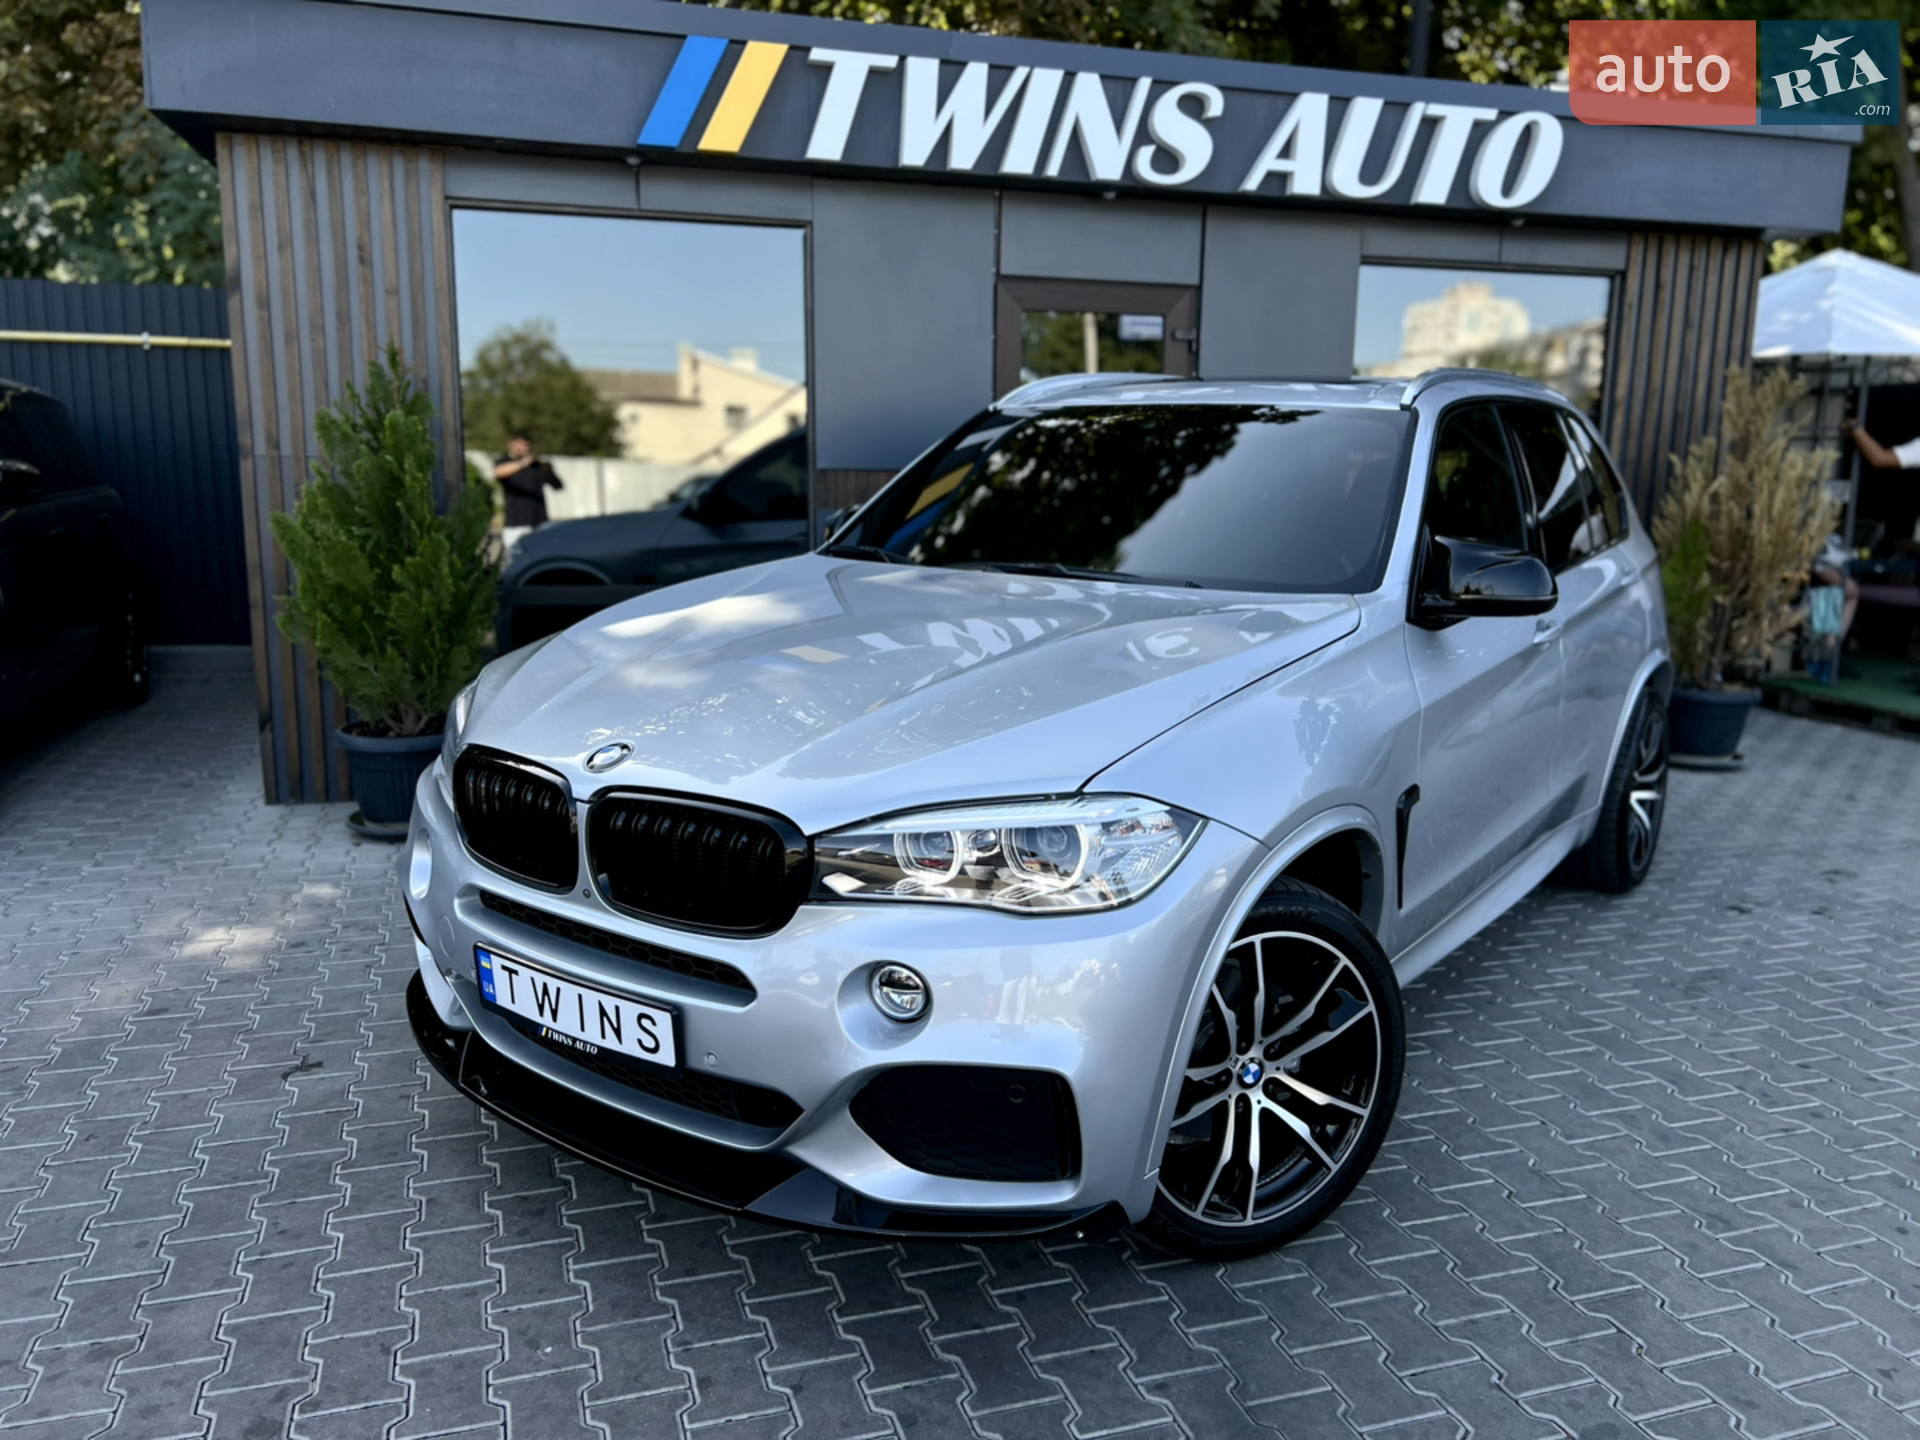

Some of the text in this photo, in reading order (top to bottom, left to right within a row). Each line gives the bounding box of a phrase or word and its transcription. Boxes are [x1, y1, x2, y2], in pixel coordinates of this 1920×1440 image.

[804, 46, 1564, 209] TWINS AUTO
[482, 980, 495, 994] UA
[501, 964, 660, 1055] TWINS
[546, 1029, 598, 1056] TWINS AUTO
